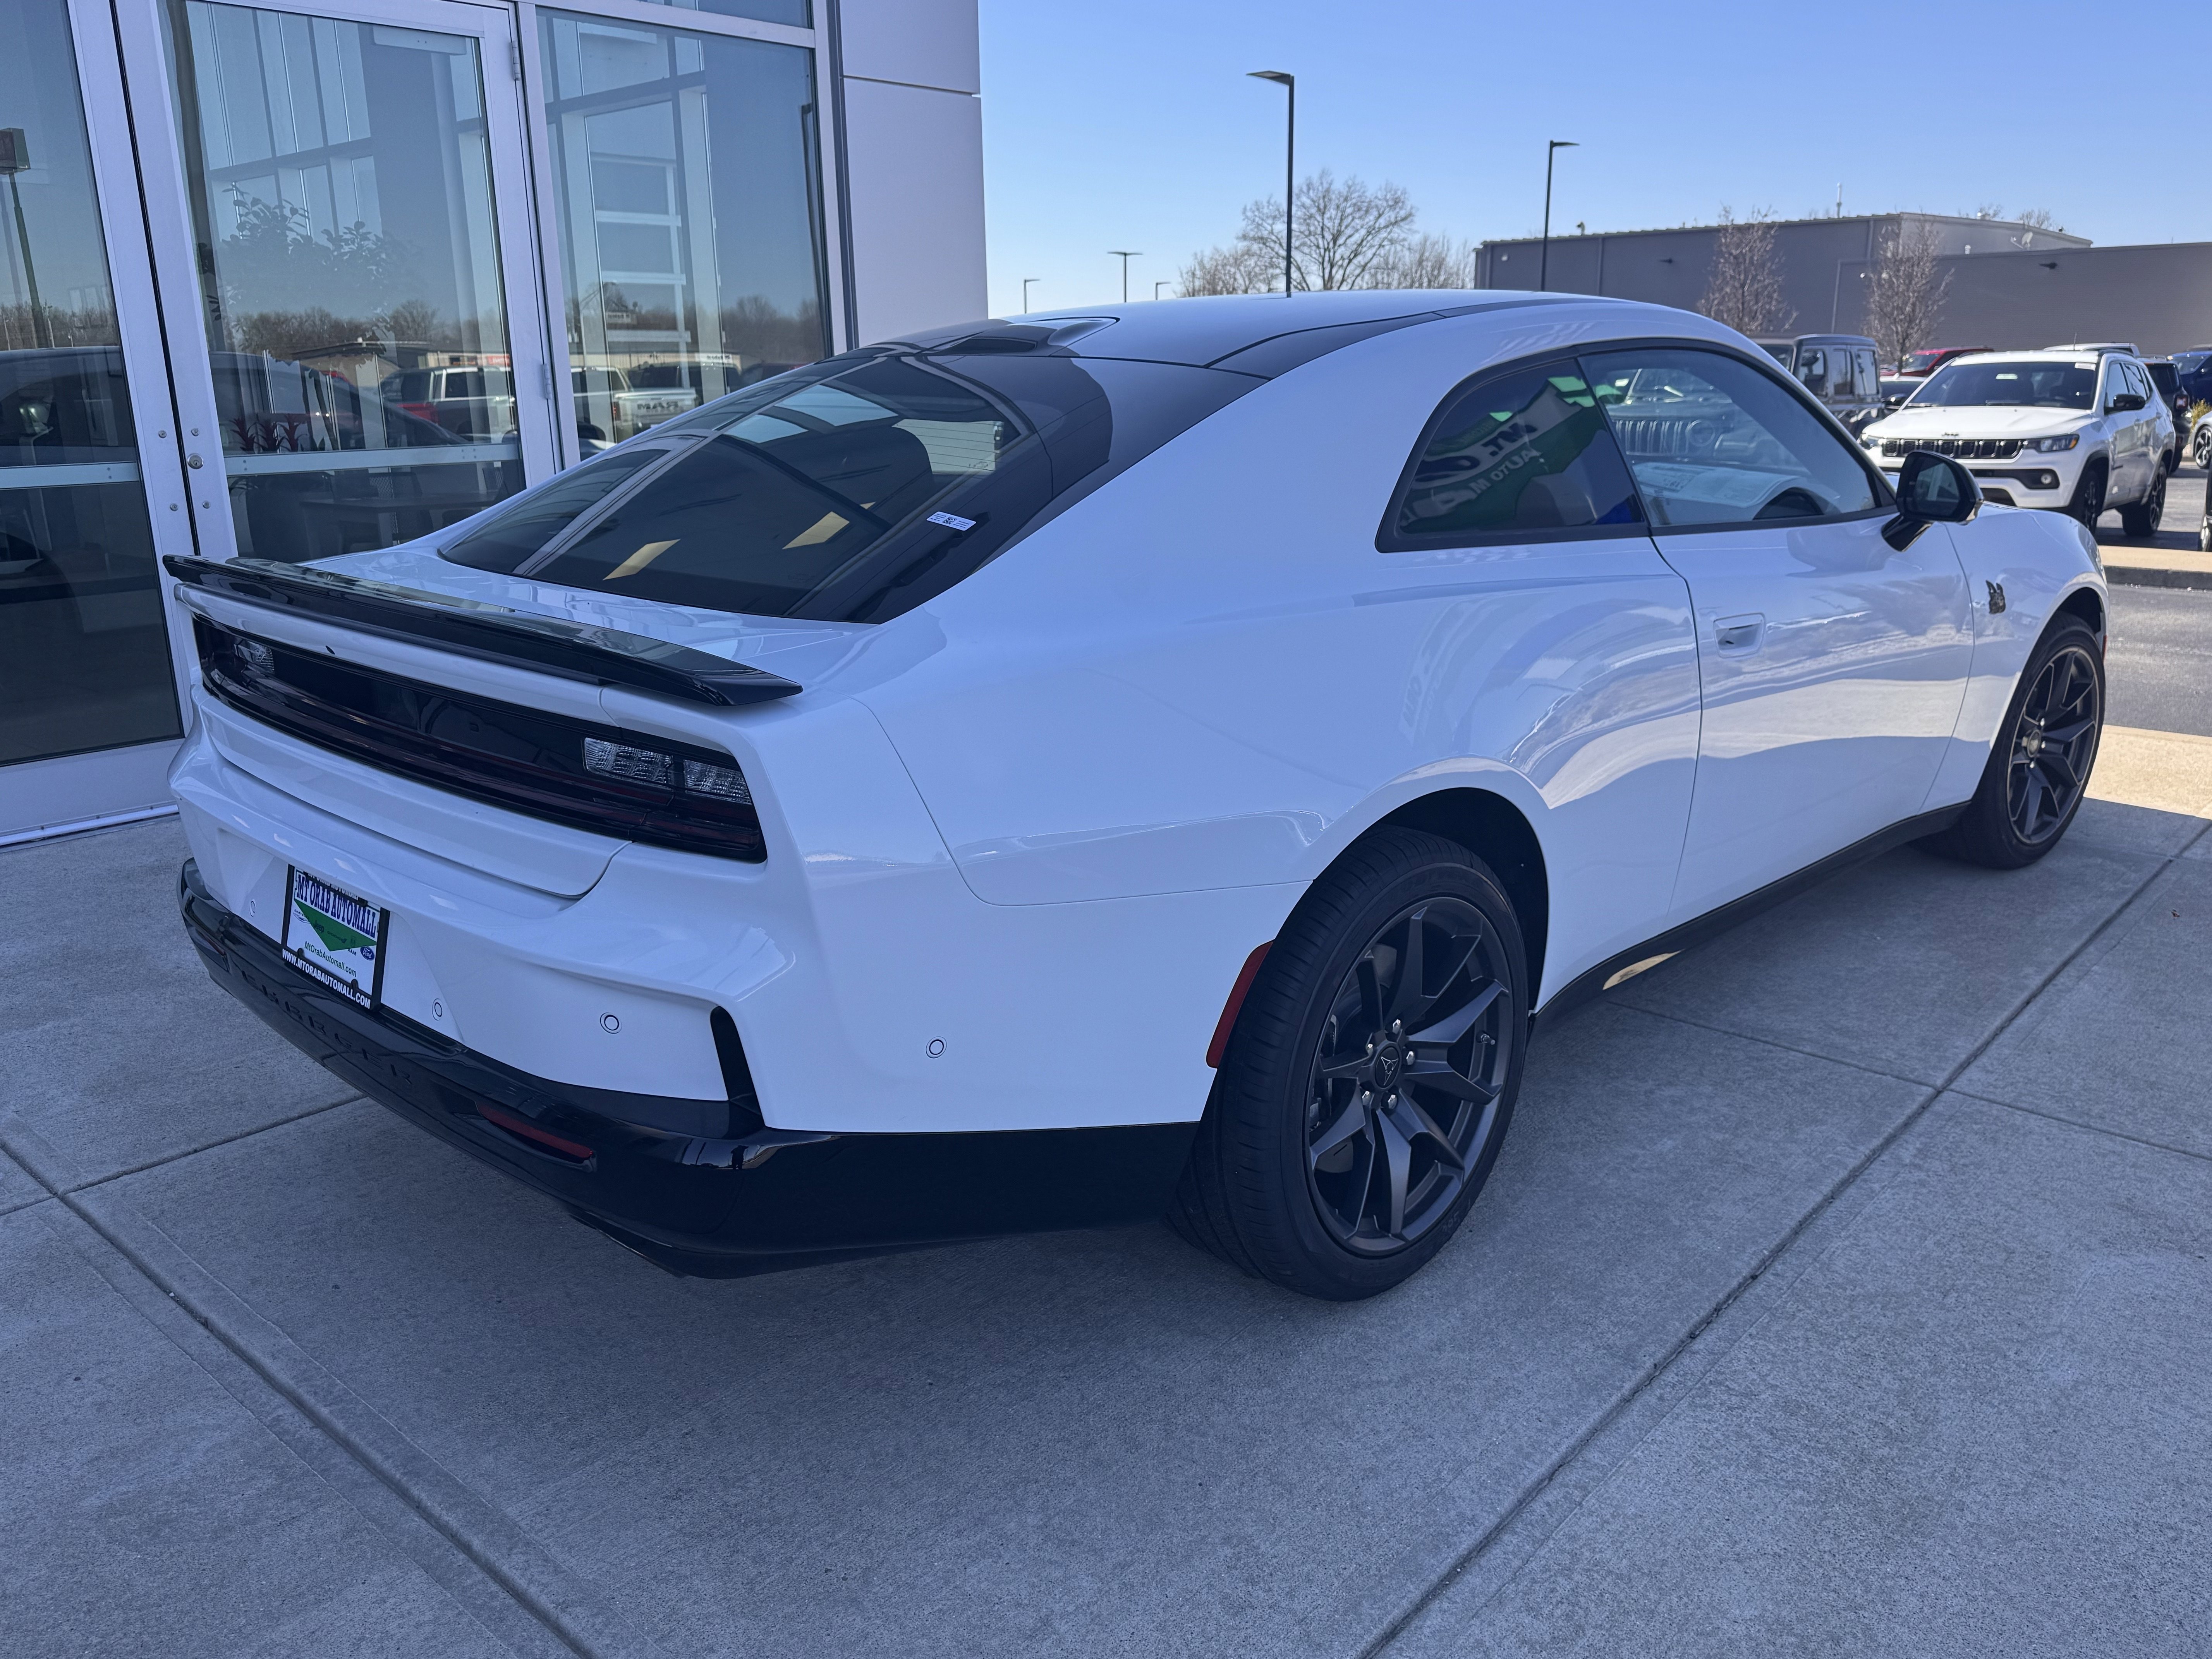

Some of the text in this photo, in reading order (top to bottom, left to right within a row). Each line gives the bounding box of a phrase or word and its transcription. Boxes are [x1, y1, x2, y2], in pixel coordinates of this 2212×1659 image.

[297, 874, 309, 903] MT
[310, 882, 331, 914] ORAB
[331, 891, 376, 938] AUTOMALL
[282, 948, 371, 1010] WWW.MTORABAUTOMALL.COM
[304, 941, 357, 977] MtOrabAutomall.com
